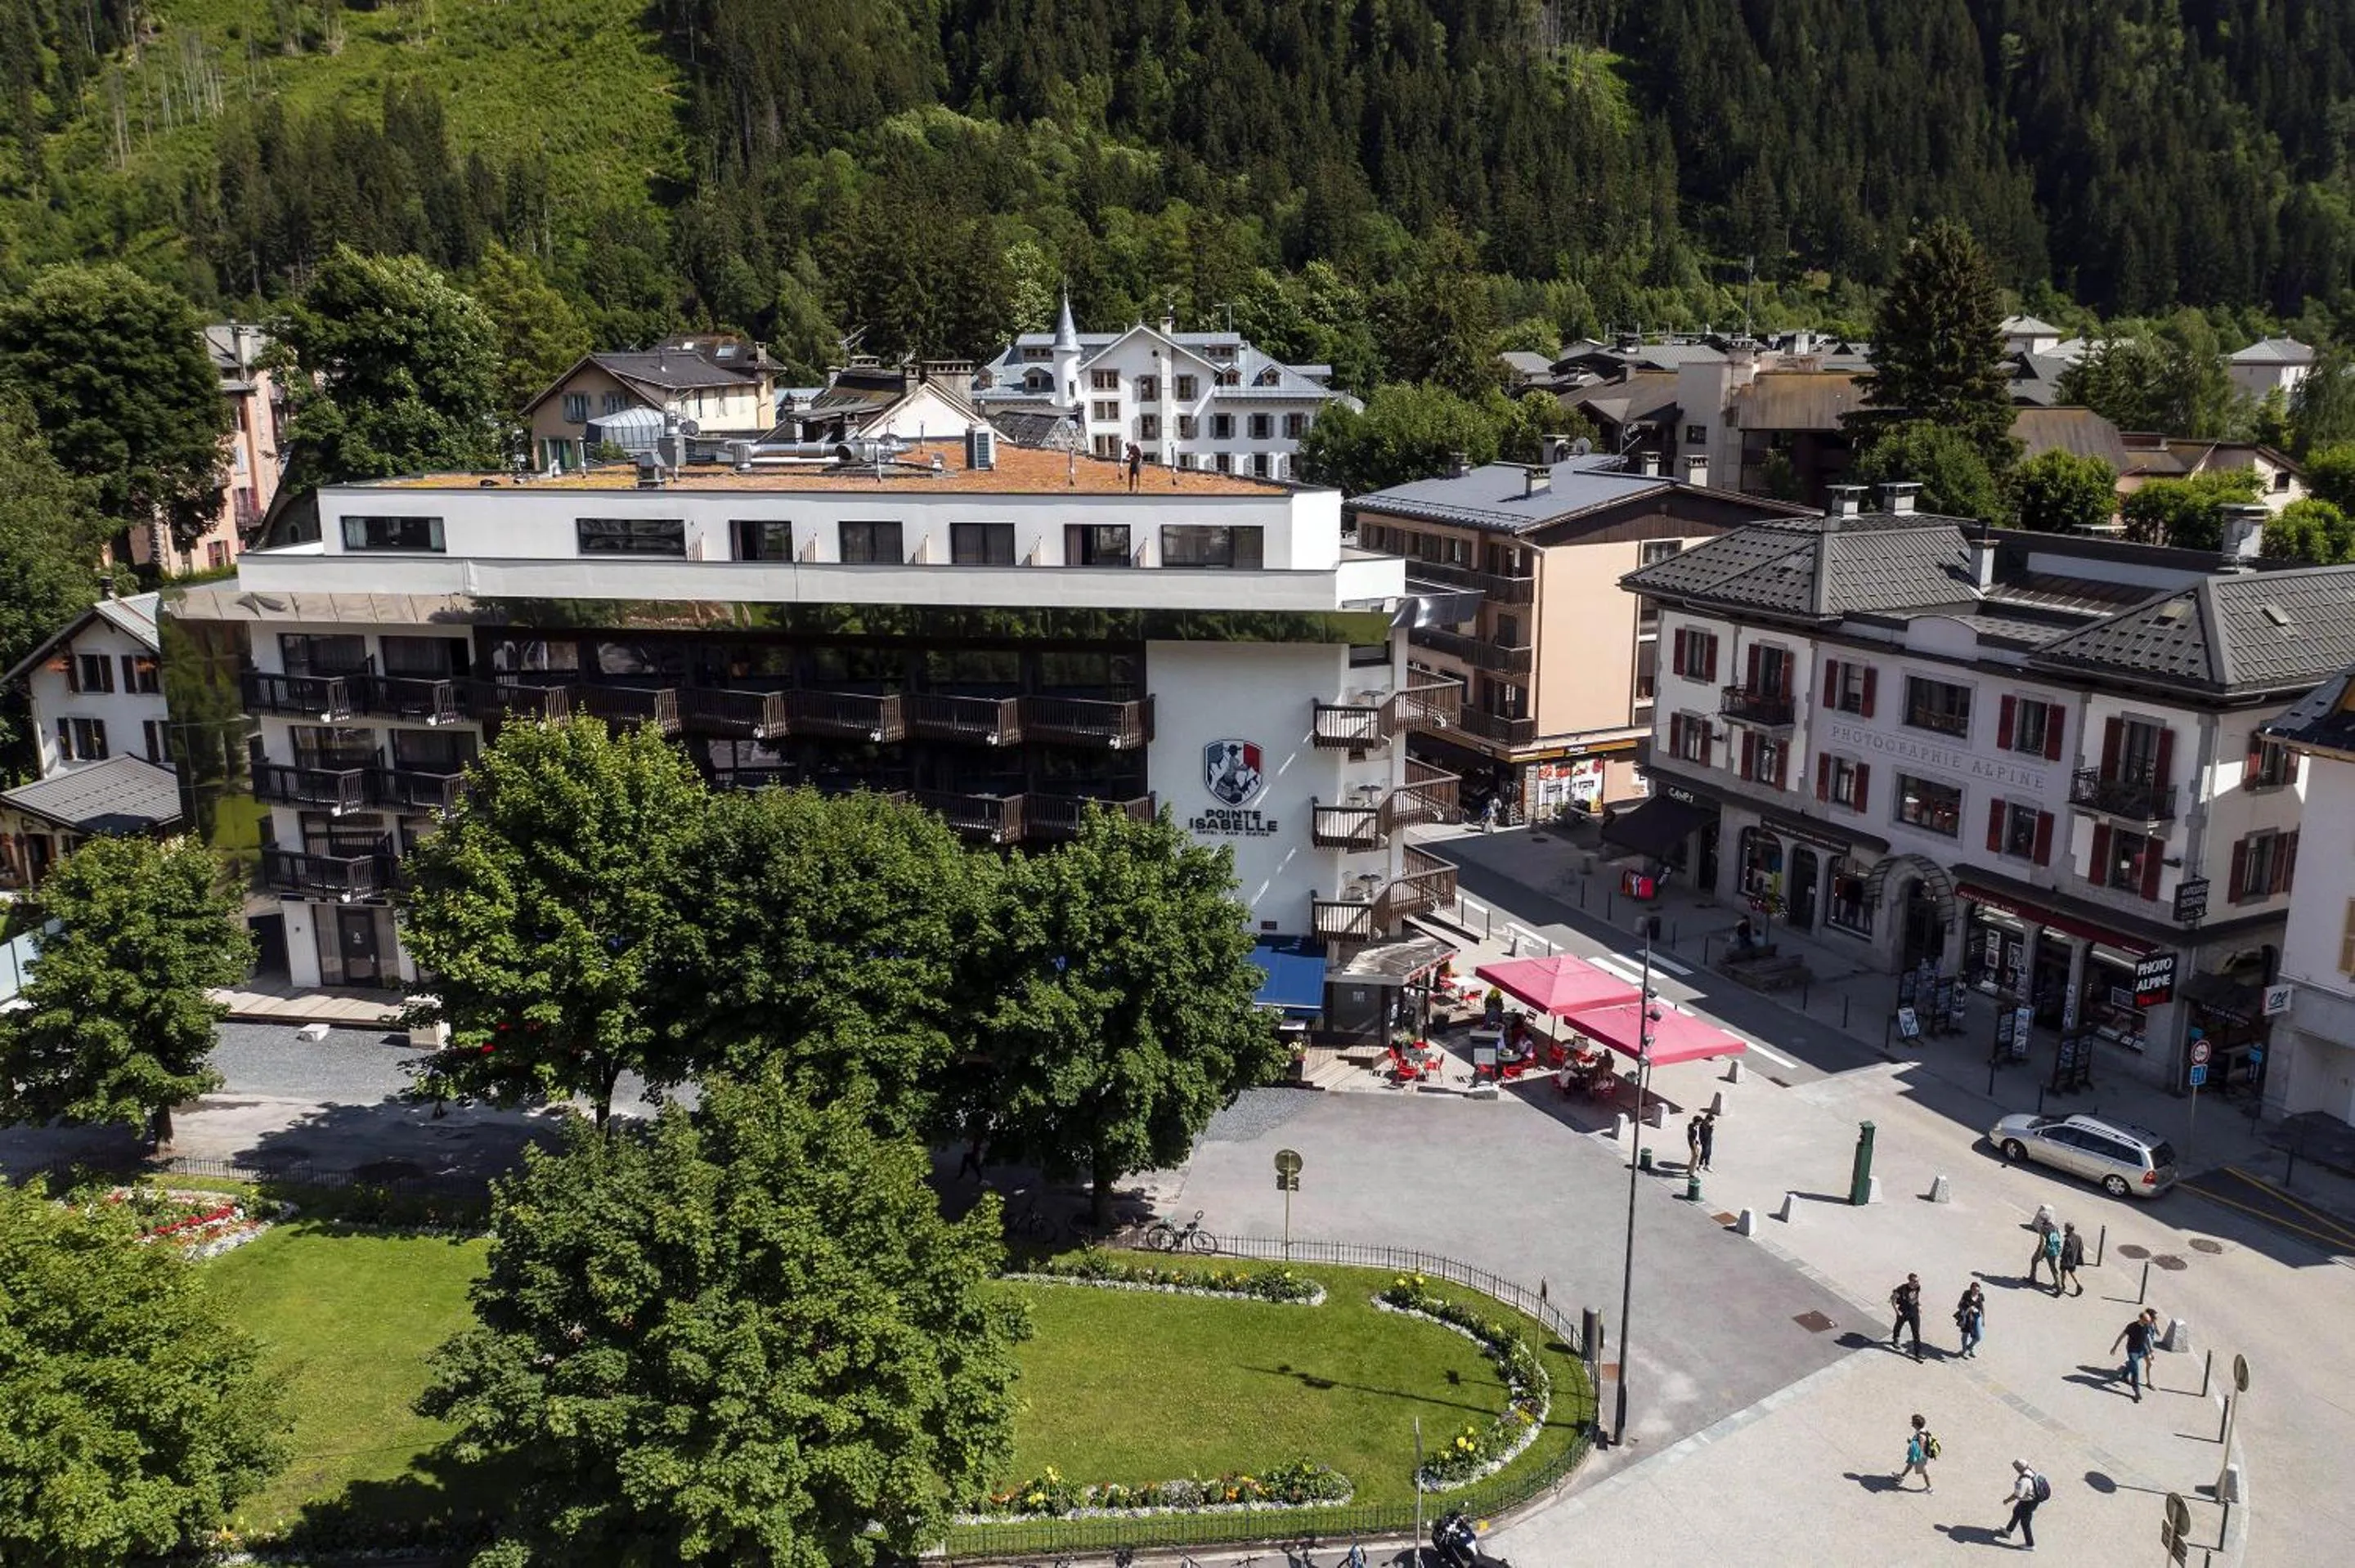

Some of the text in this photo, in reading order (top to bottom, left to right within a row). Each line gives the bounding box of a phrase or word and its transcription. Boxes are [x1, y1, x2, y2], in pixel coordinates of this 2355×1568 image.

[1832, 726, 2044, 789] PHOTOGRAPHIE ALPINE
[1205, 809, 1262, 820] POINTE
[1189, 818, 1278, 832] ISABELLE
[2137, 956, 2173, 977] PHOTO
[2136, 974, 2171, 993] ALPINE
